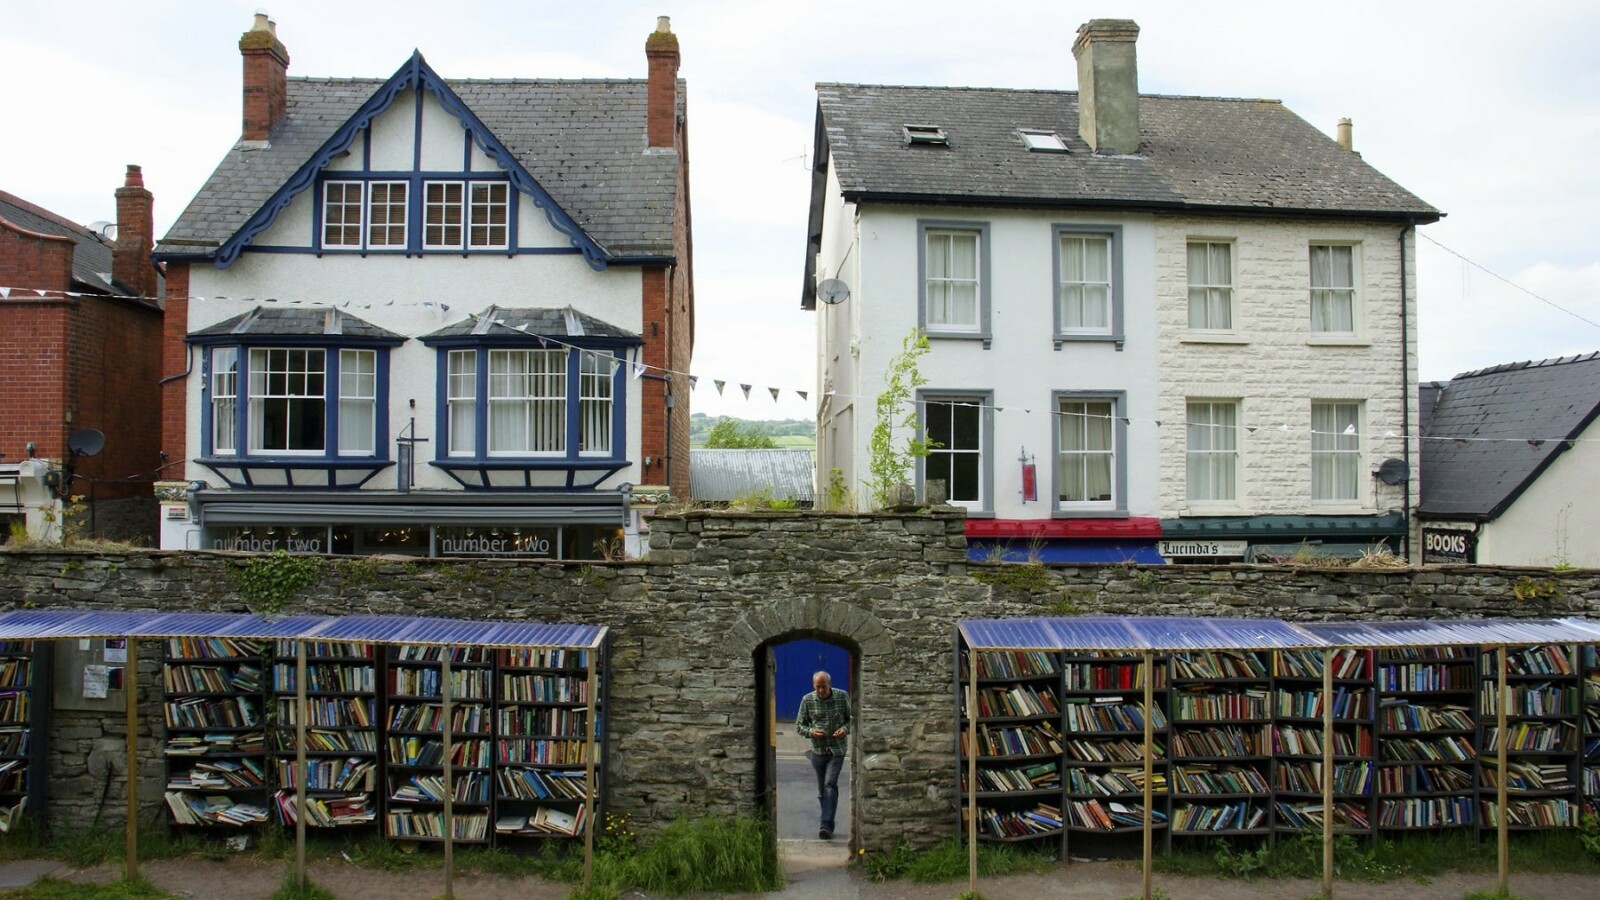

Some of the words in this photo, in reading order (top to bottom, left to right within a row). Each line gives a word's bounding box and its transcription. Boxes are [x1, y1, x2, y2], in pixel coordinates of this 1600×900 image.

[214, 535, 279, 551] number
[287, 536, 320, 551] two
[443, 534, 507, 551] number
[517, 536, 549, 551] two
[1162, 541, 1218, 554] Lucinda's
[1426, 534, 1466, 553] BOOKS
